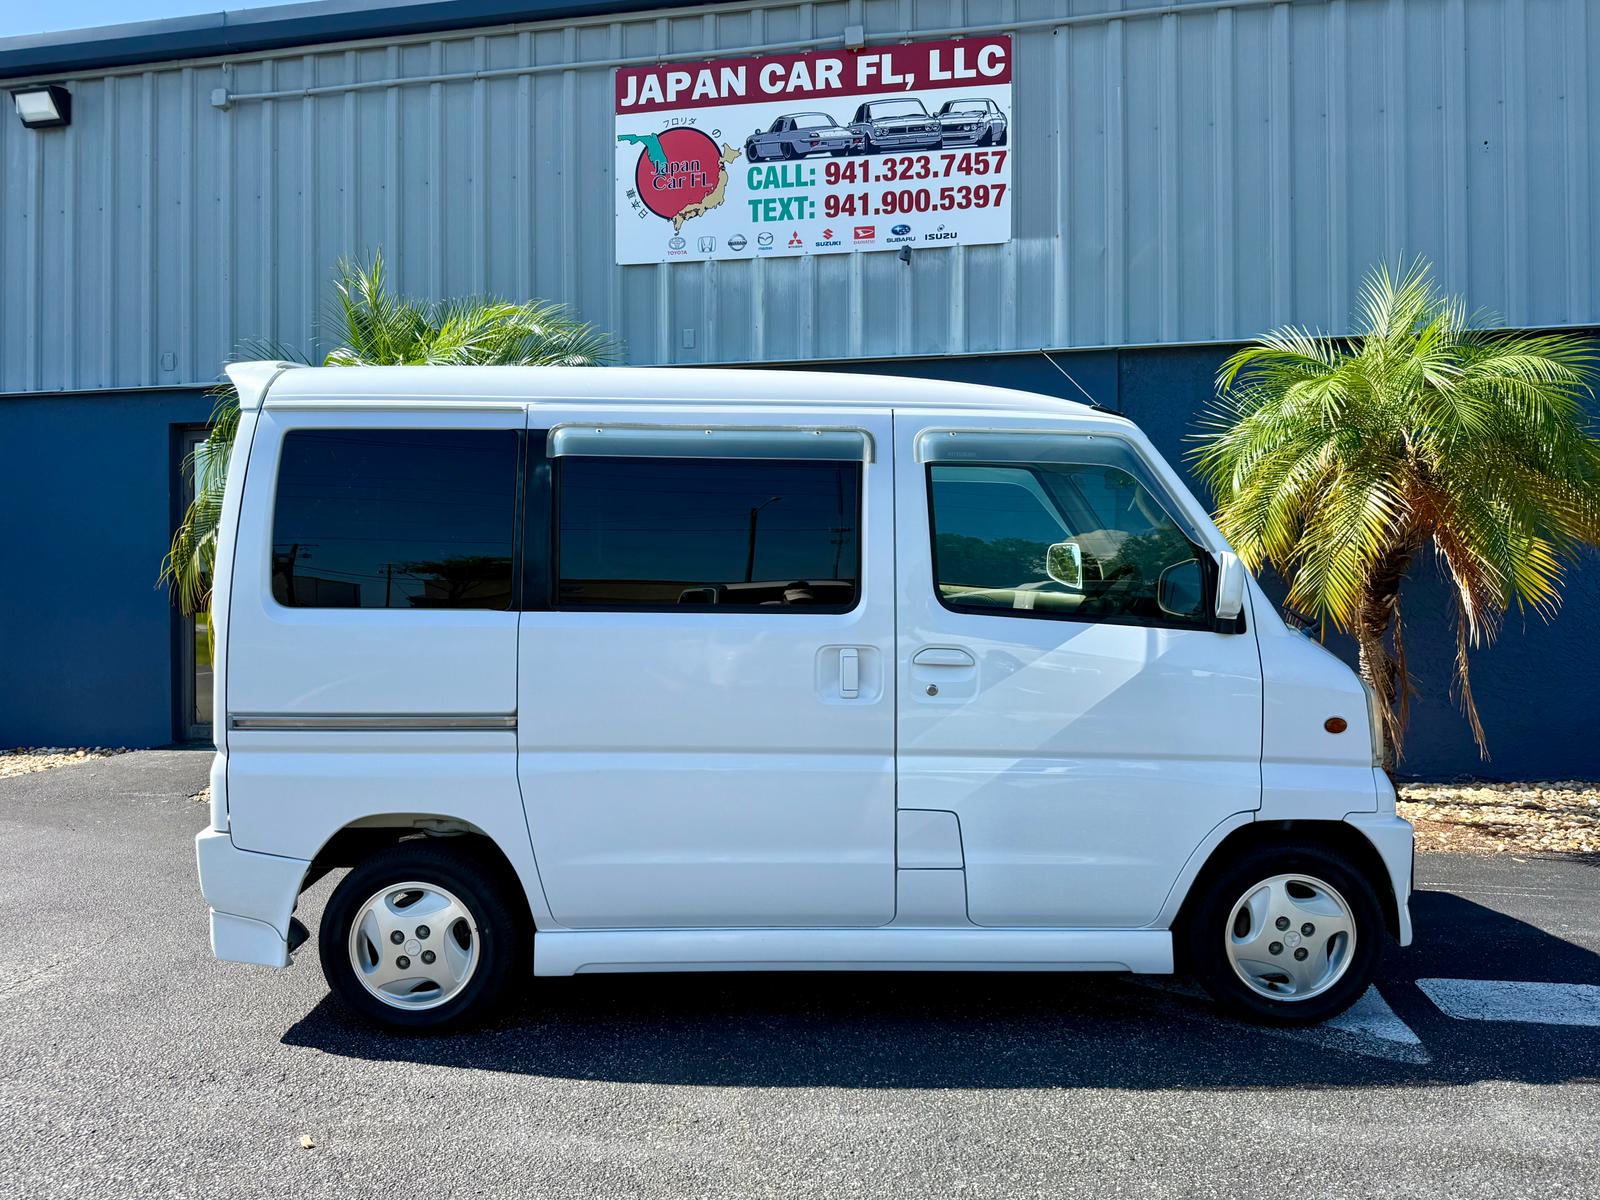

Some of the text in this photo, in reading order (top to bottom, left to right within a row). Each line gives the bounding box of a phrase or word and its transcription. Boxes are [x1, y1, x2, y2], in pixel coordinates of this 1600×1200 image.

[620, 44, 1006, 107] JAPAN CAR FL, LLC
[663, 117, 722, 139] フロリダ の
[651, 159, 701, 177] Japan
[746, 150, 1008, 191] CALL: 941.323.7457
[652, 172, 713, 190] Car FL
[747, 183, 1007, 223] TEXT: 941.900.5397
[886, 235, 916, 243] SUBARU
[924, 231, 958, 241] ISUZU
